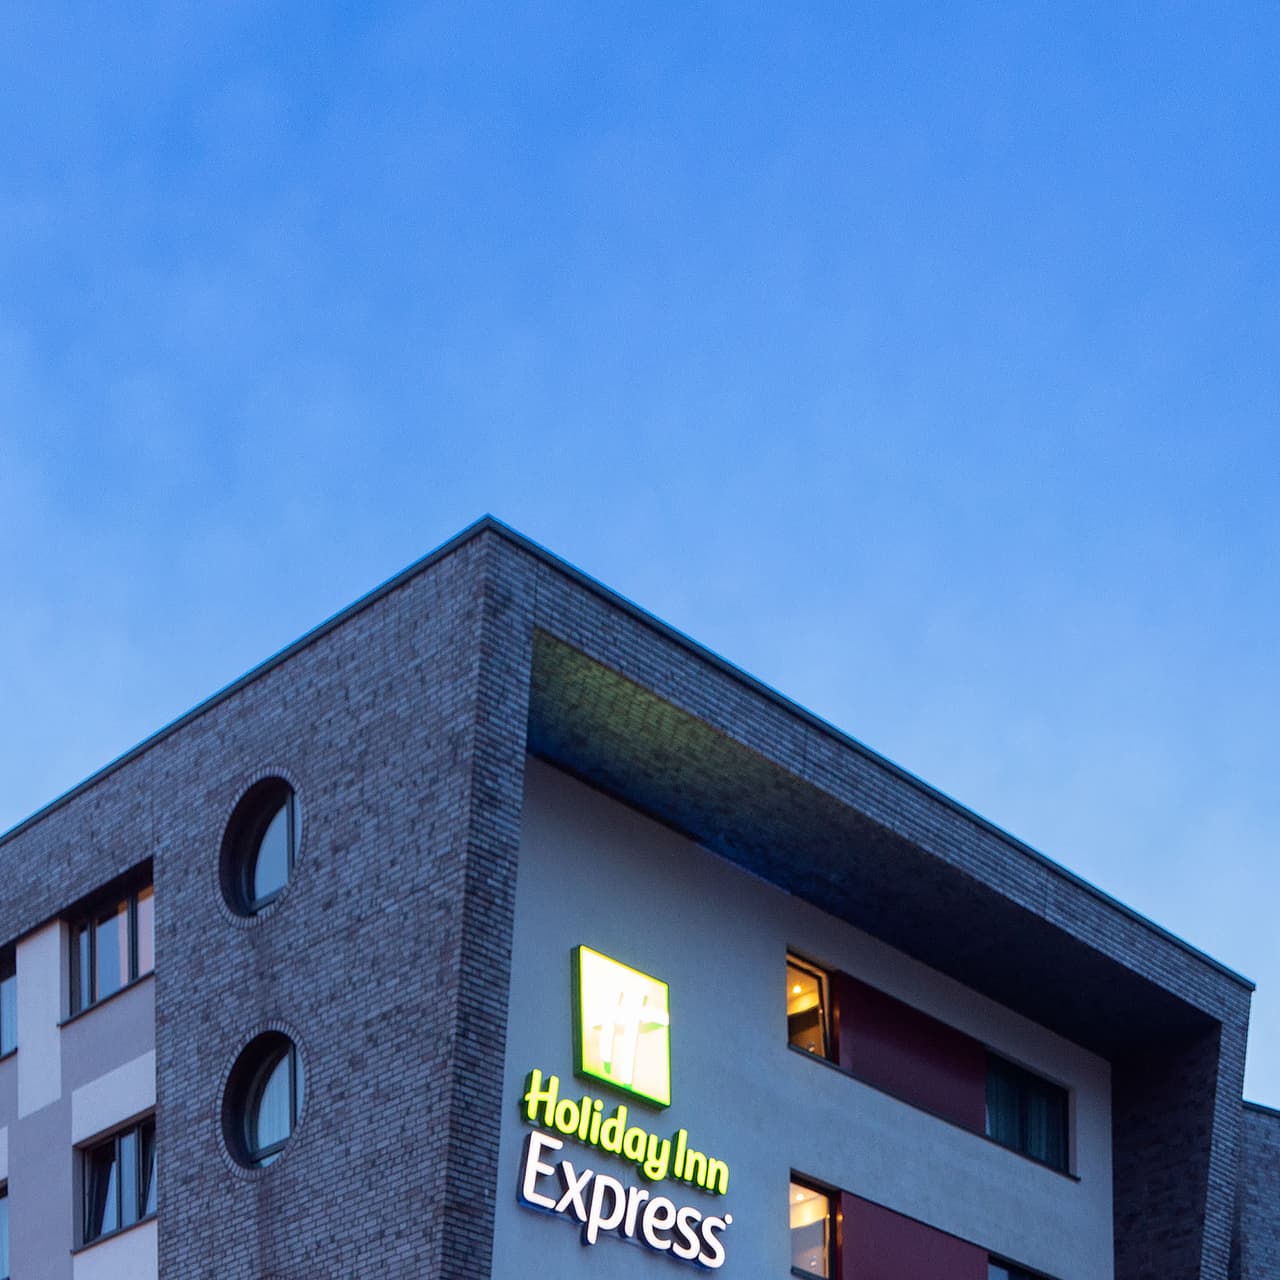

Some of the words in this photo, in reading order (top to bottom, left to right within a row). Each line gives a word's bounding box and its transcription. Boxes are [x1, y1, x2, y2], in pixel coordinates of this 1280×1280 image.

[524, 1069, 671, 1181] Holiday
[673, 1128, 730, 1195] Inn
[522, 1130, 728, 1269] Express
